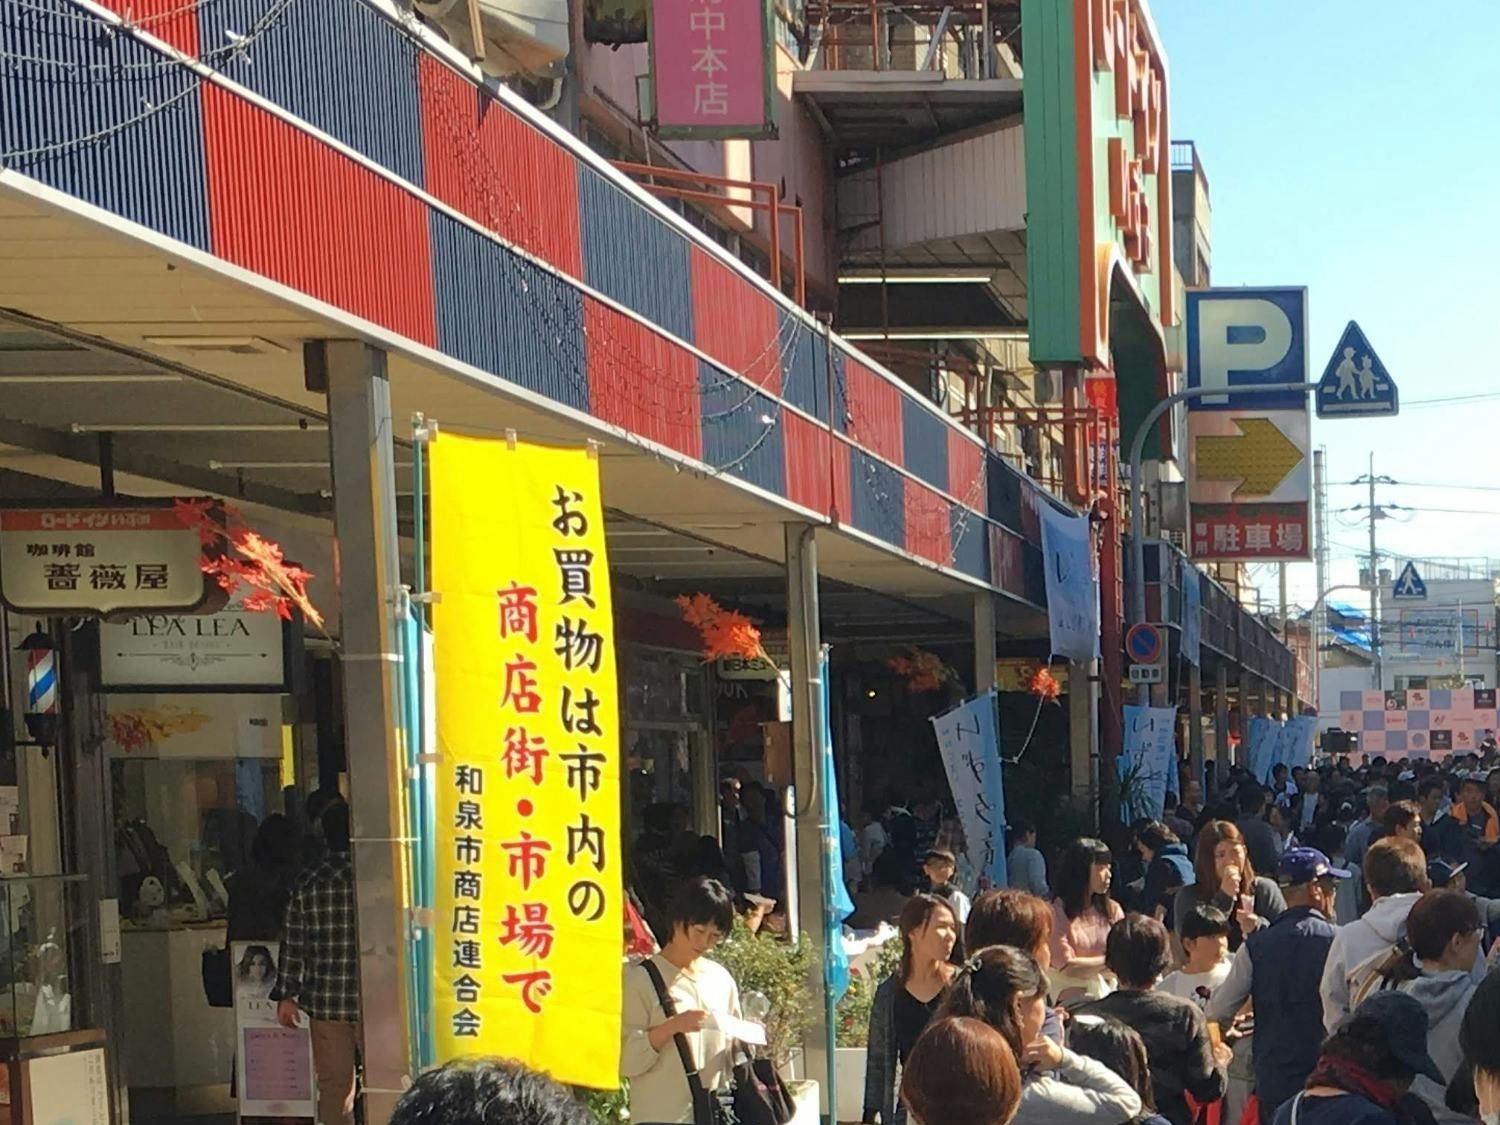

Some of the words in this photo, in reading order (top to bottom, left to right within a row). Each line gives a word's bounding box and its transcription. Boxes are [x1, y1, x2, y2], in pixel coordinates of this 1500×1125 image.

[690, 0, 728, 115] 中本店
[27, 543, 95, 558] 珈琲館
[1214, 523, 1303, 552] 駐車場
[44, 563, 168, 590] 薔薇屋
[196, 618, 250, 636] LEA
[552, 485, 607, 921] お買物は市内の
[497, 581, 555, 1014] 商店街・市場で
[452, 765, 484, 1037] 和泉市商店連合会
